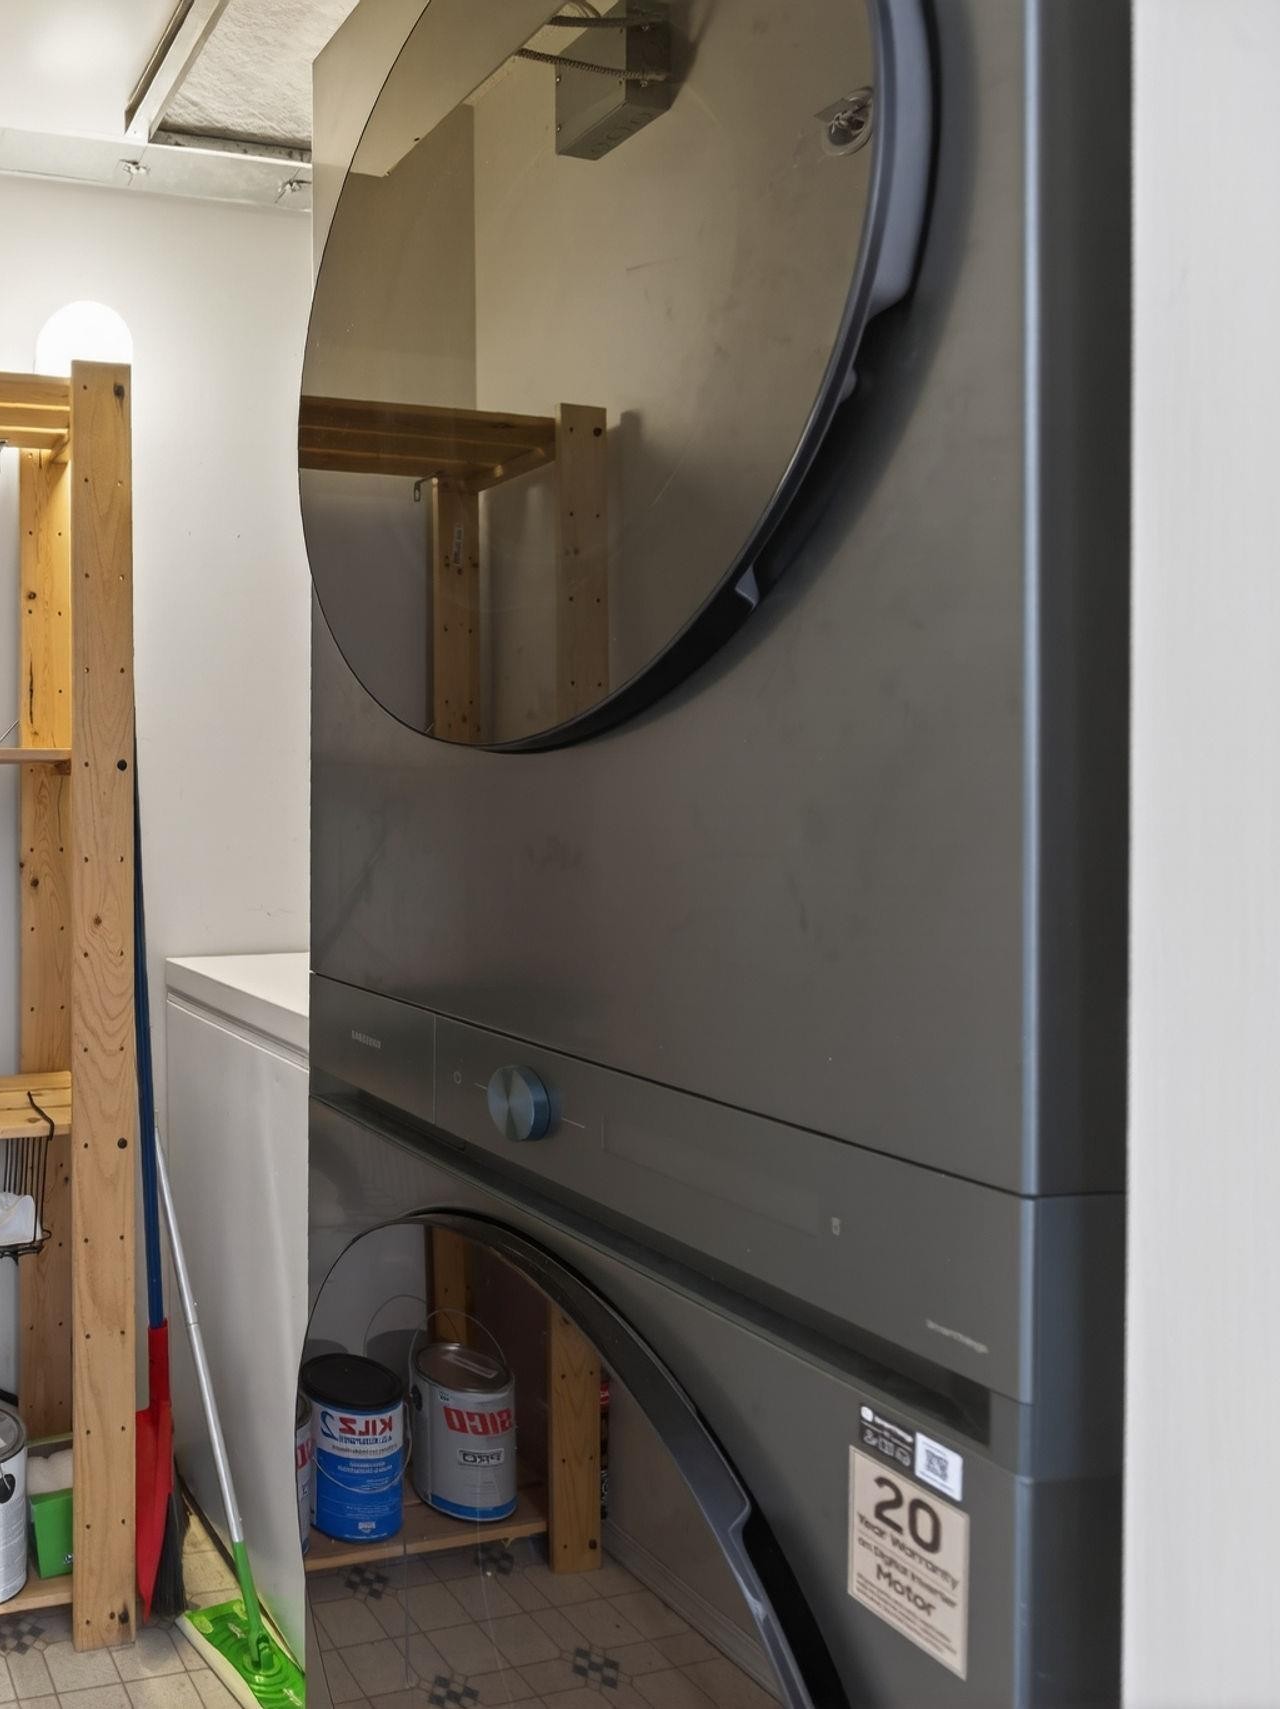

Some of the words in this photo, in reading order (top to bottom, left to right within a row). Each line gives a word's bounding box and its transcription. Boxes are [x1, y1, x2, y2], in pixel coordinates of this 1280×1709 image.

[857, 1511, 887, 1539] Year
[890, 1533, 960, 1591] Warranty
[874, 1476, 942, 1554] 20
[876, 1562, 937, 1617] Motor
